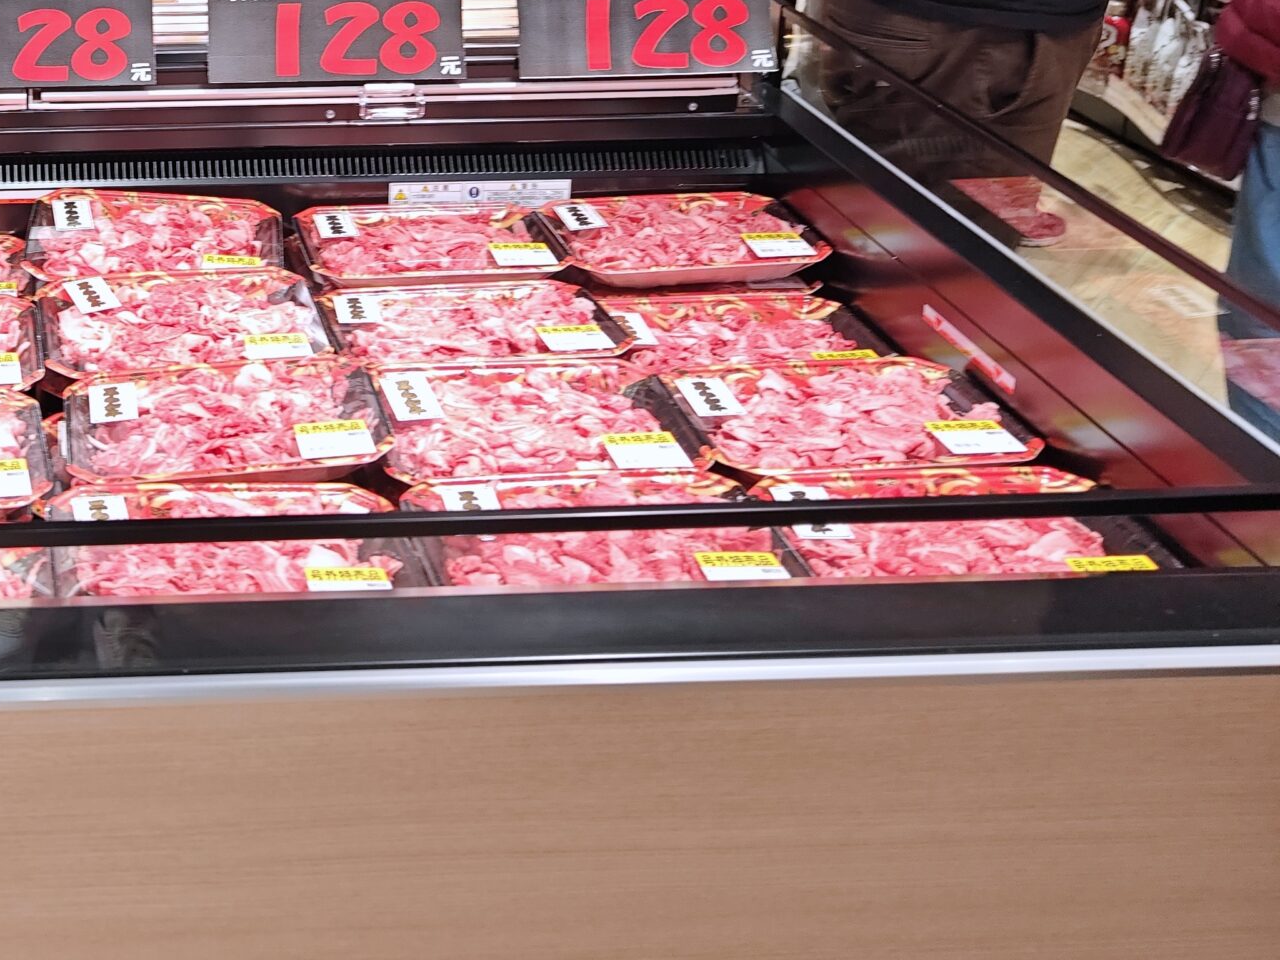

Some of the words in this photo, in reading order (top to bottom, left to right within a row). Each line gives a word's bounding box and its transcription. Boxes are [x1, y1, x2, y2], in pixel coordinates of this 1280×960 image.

[275, 1, 441, 77] 128
[440, 56, 462, 76] 元
[751, 49, 774, 67] 元
[130, 62, 152, 82] 元
